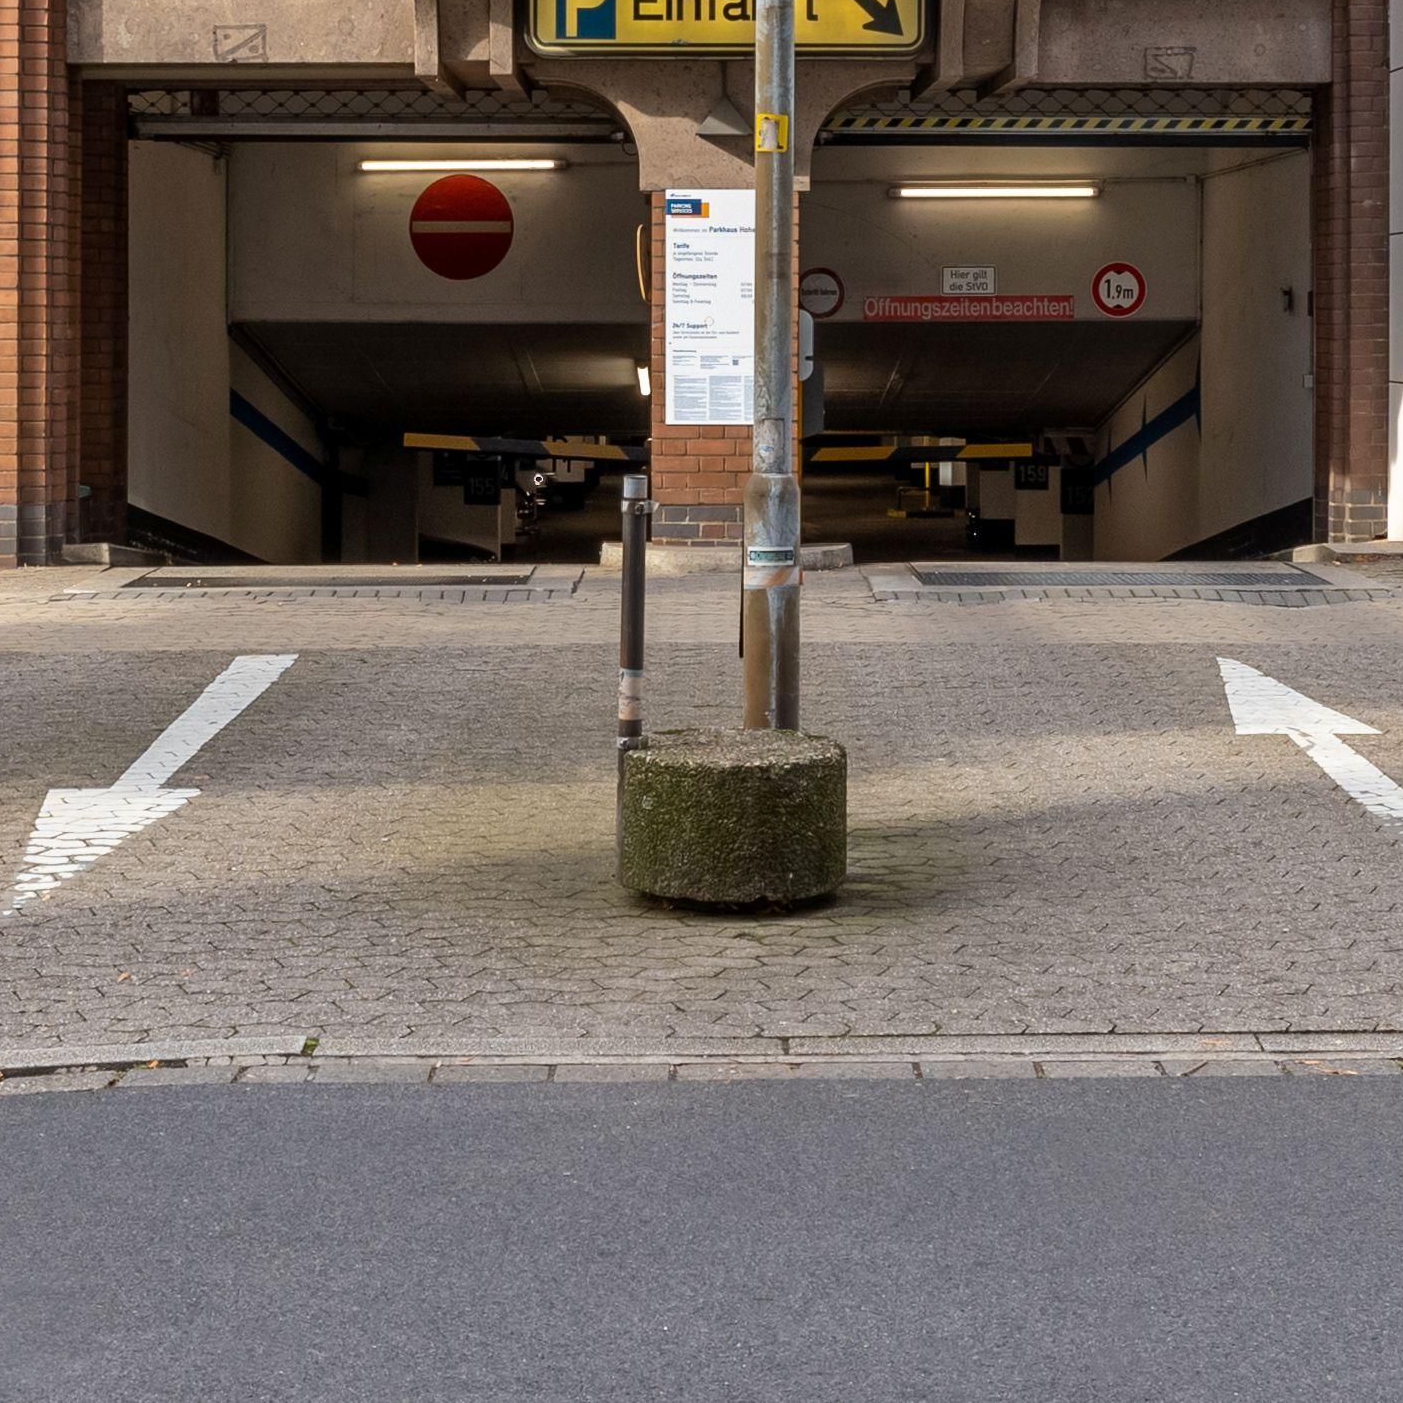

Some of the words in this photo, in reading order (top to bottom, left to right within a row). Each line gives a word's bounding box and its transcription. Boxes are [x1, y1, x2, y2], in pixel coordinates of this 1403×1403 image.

[672, 272, 718, 280] Öffnungszeiten
[950, 270, 970, 280] Hier
[972, 270, 988, 282] gilt
[949, 282, 964, 292] die
[965, 282, 989, 292] StVO
